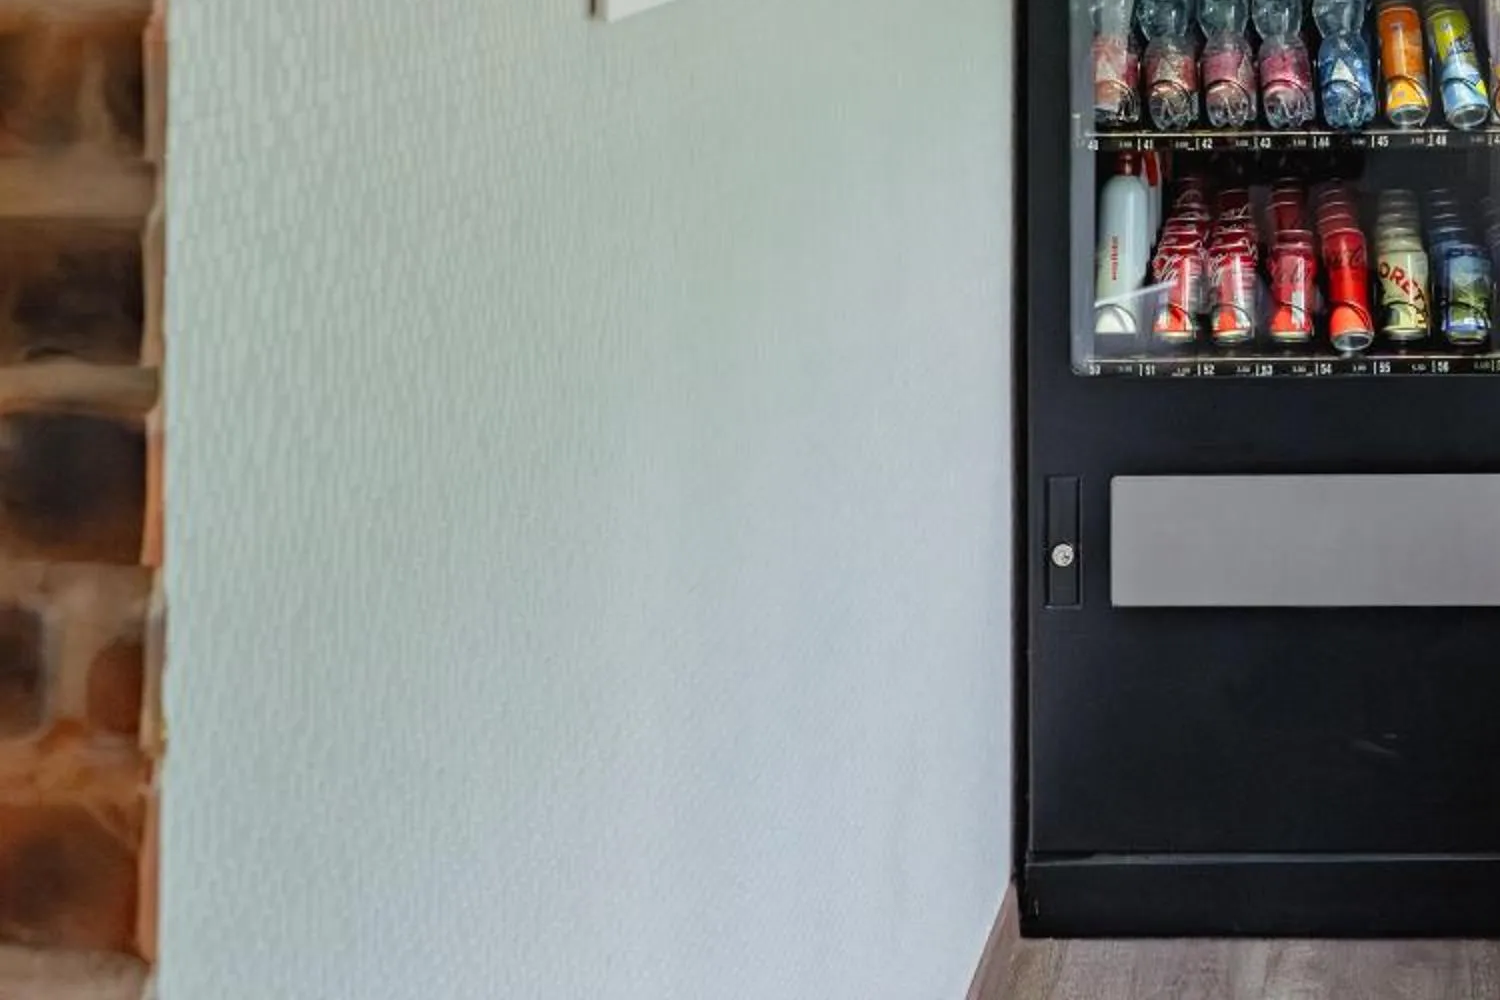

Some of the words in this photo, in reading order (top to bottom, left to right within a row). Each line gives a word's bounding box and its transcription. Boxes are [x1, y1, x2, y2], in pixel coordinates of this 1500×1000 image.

[1201, 137, 1213, 149] 42
[1259, 137, 1271, 149] 43
[1376, 135, 1389, 148] 45
[1203, 363, 1216, 375] 52
[1320, 362, 1333, 375] 54
[1378, 361, 1391, 373] 55
